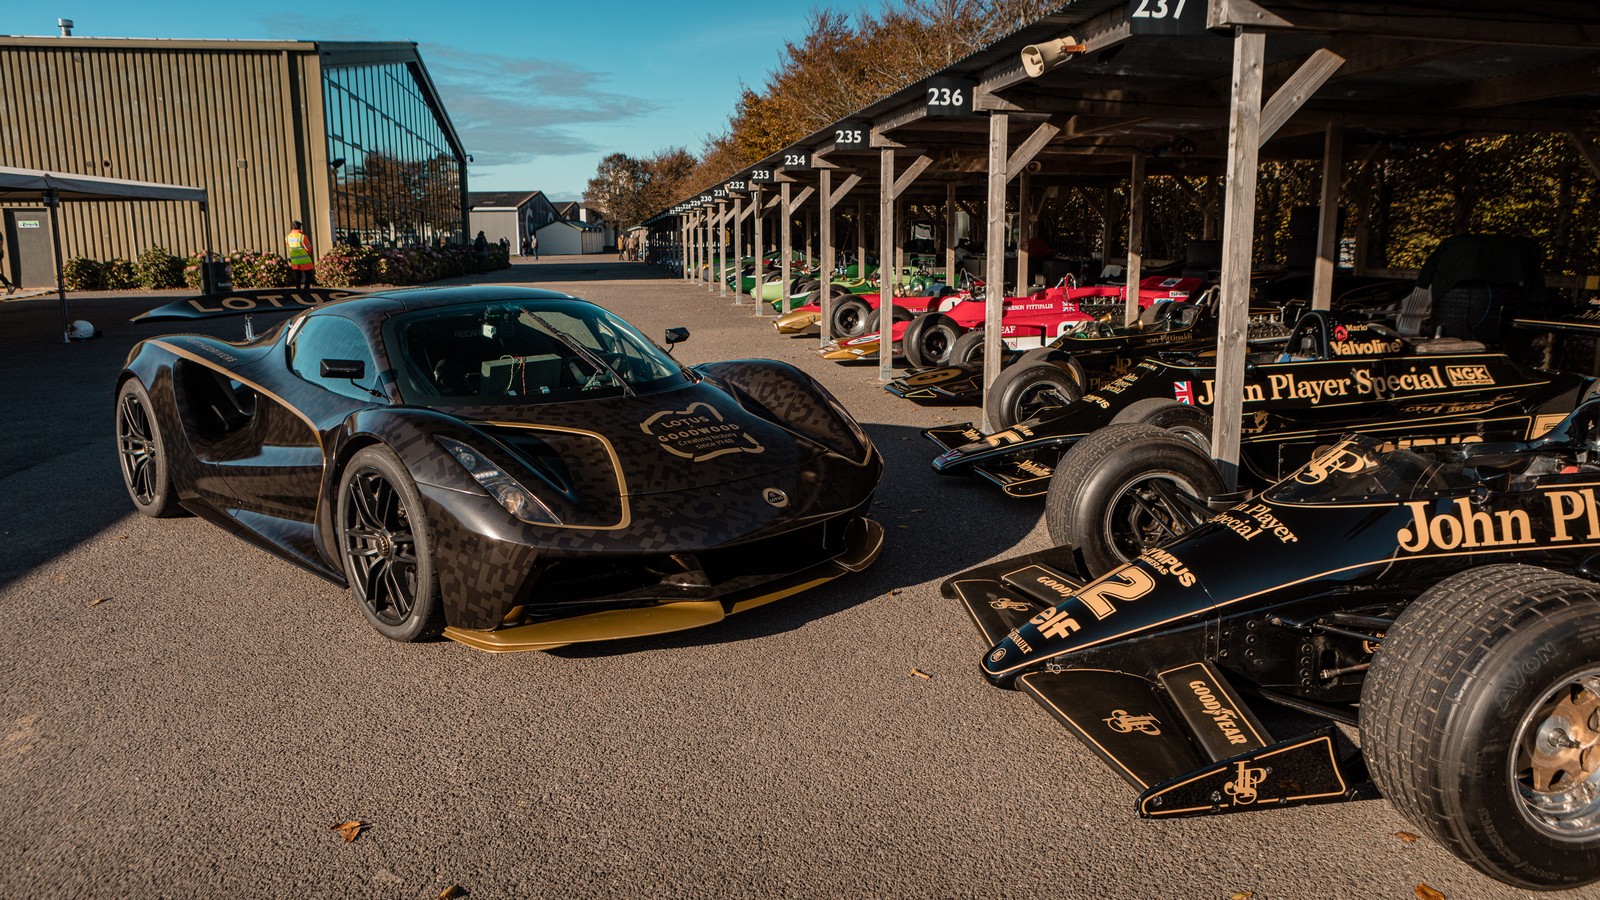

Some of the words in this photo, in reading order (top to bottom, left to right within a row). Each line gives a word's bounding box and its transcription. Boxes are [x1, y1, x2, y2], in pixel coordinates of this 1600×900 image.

[1132, 0, 1186, 19] 237
[928, 87, 963, 106] 236
[835, 130, 862, 144] 235
[784, 155, 806, 166] 234
[752, 170, 769, 179] 233
[729, 181, 745, 189] 232
[1330, 338, 1402, 355] Valvoline
[1448, 367, 1489, 381] NGK
[1198, 379, 1265, 405] Jn
[1268, 373, 1350, 404] Player
[1356, 366, 1447, 400] Special
[661, 416, 710, 428] LOTUS
[658, 424, 740, 442] GOODWOOD
[677, 437, 712, 447] Creating
[711, 432, 738, 441] history
[1244, 503, 1299, 543] Player
[1397, 496, 1536, 552] John
[1136, 554, 1169, 575] AMERAS
[1141, 547, 1197, 588] YMPUS
[1077, 565, 1155, 620] 2
[1029, 606, 1082, 639] elf
[1007, 628, 1033, 655] ENAULT
[1496, 641, 1559, 713] AVON
[1189, 680, 1248, 745] GOODYEAR
